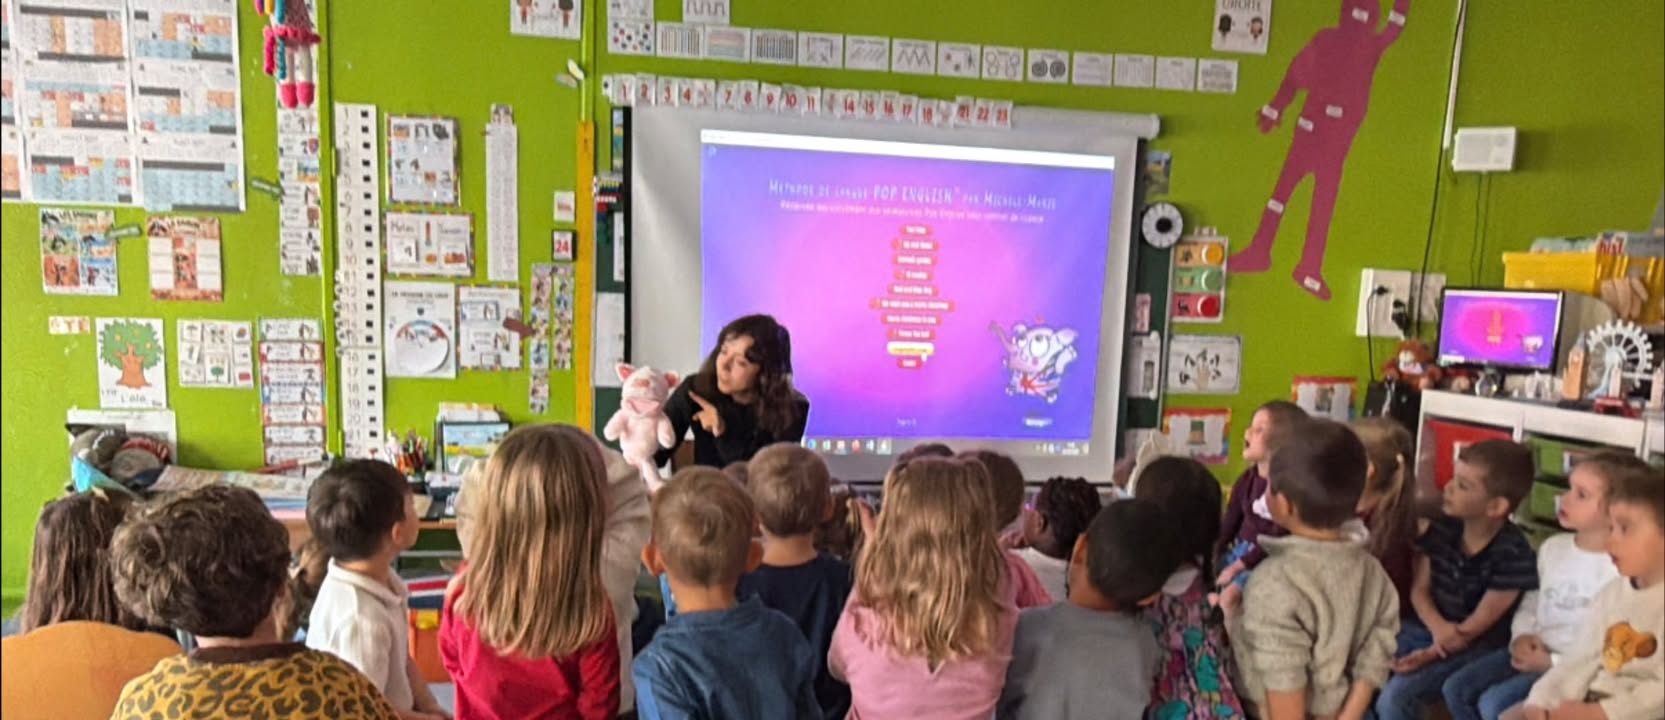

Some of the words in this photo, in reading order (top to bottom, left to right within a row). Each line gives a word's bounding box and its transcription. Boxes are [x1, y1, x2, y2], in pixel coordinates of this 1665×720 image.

[622, 84, 627, 100] 1
[641, 84, 648, 99] 2
[665, 86, 671, 101] 3
[683, 88, 691, 101] 4
[725, 89, 732, 102] 7
[744, 91, 752, 104] 8
[767, 92, 774, 106] 9
[785, 93, 797, 107] 10
[807, 95, 815, 110] 11
[844, 98, 854, 113] 14
[864, 99, 874, 113] 15
[884, 101, 893, 115] 16
[903, 103, 912, 118] 17
[923, 107, 932, 122] 18
[959, 103, 970, 118] 21
[977, 106, 988, 121] 22
[873, 184, 898, 201] POP
[556, 239, 569, 254] 24
